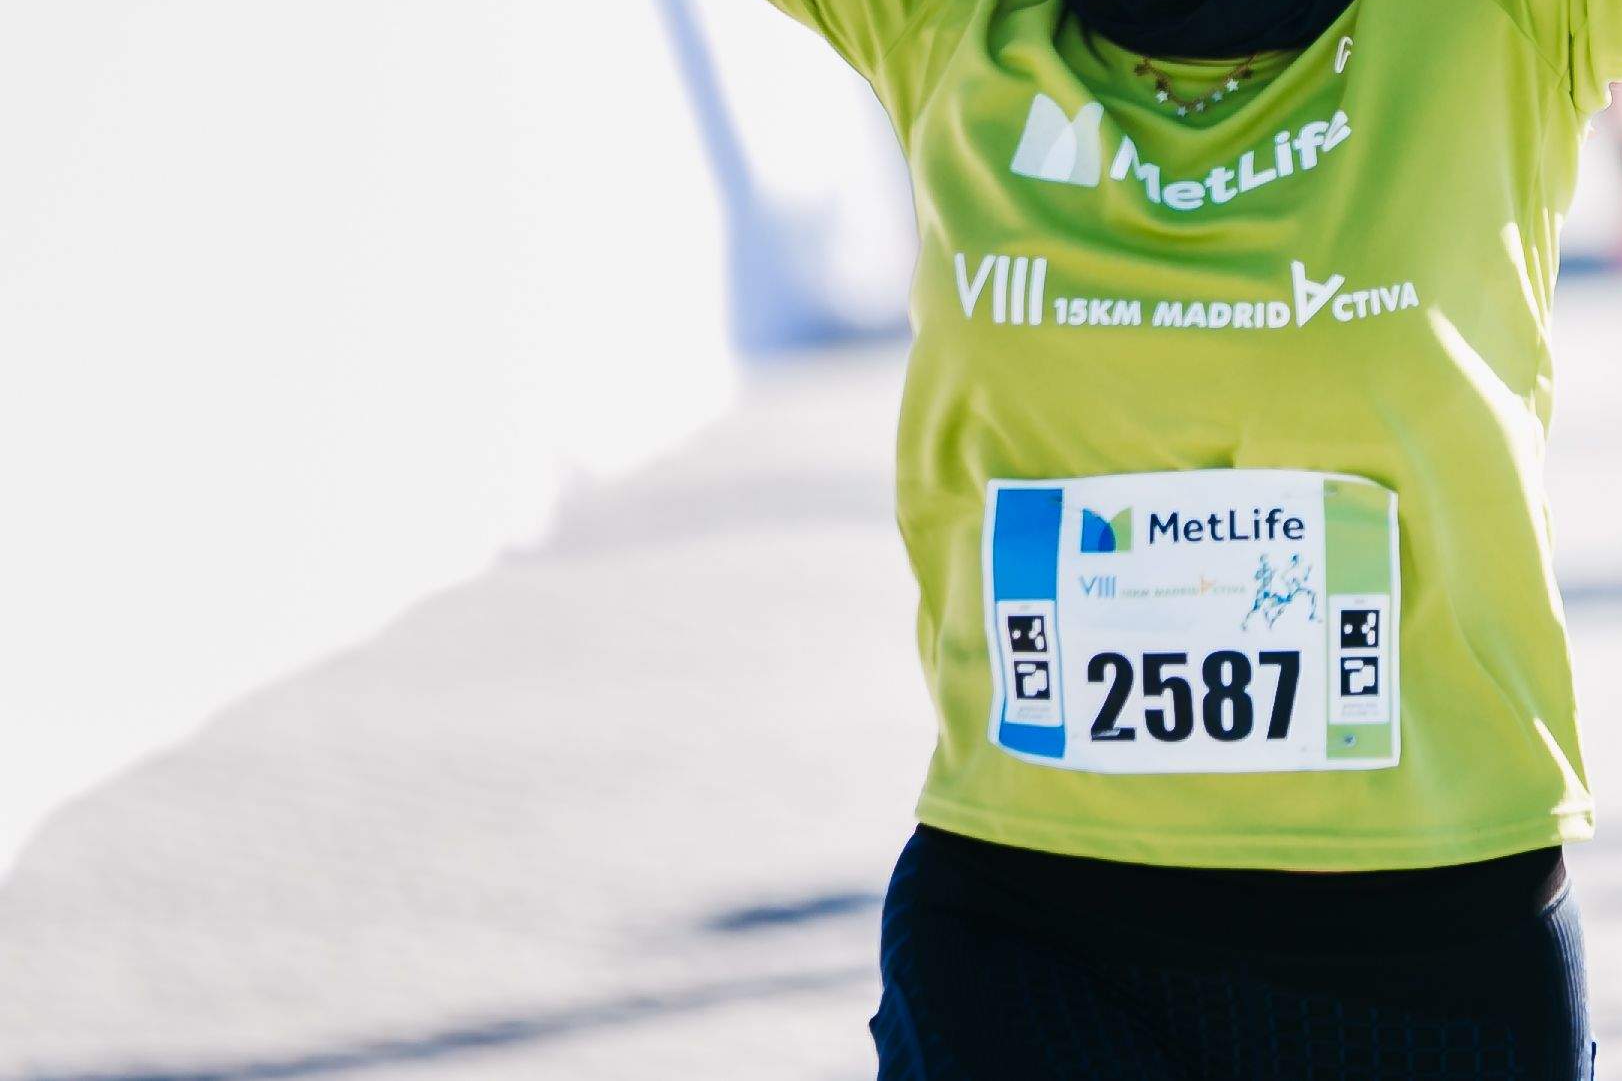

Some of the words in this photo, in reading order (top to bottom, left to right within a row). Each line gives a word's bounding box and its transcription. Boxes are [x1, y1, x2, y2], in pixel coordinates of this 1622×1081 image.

[953, 252, 1048, 325] VIII
[1053, 297, 1141, 326] 15KM
[1151, 300, 1291, 329] MADRID
[1149, 506, 1304, 545] MetLife
[1086, 650, 1302, 742] 2587
